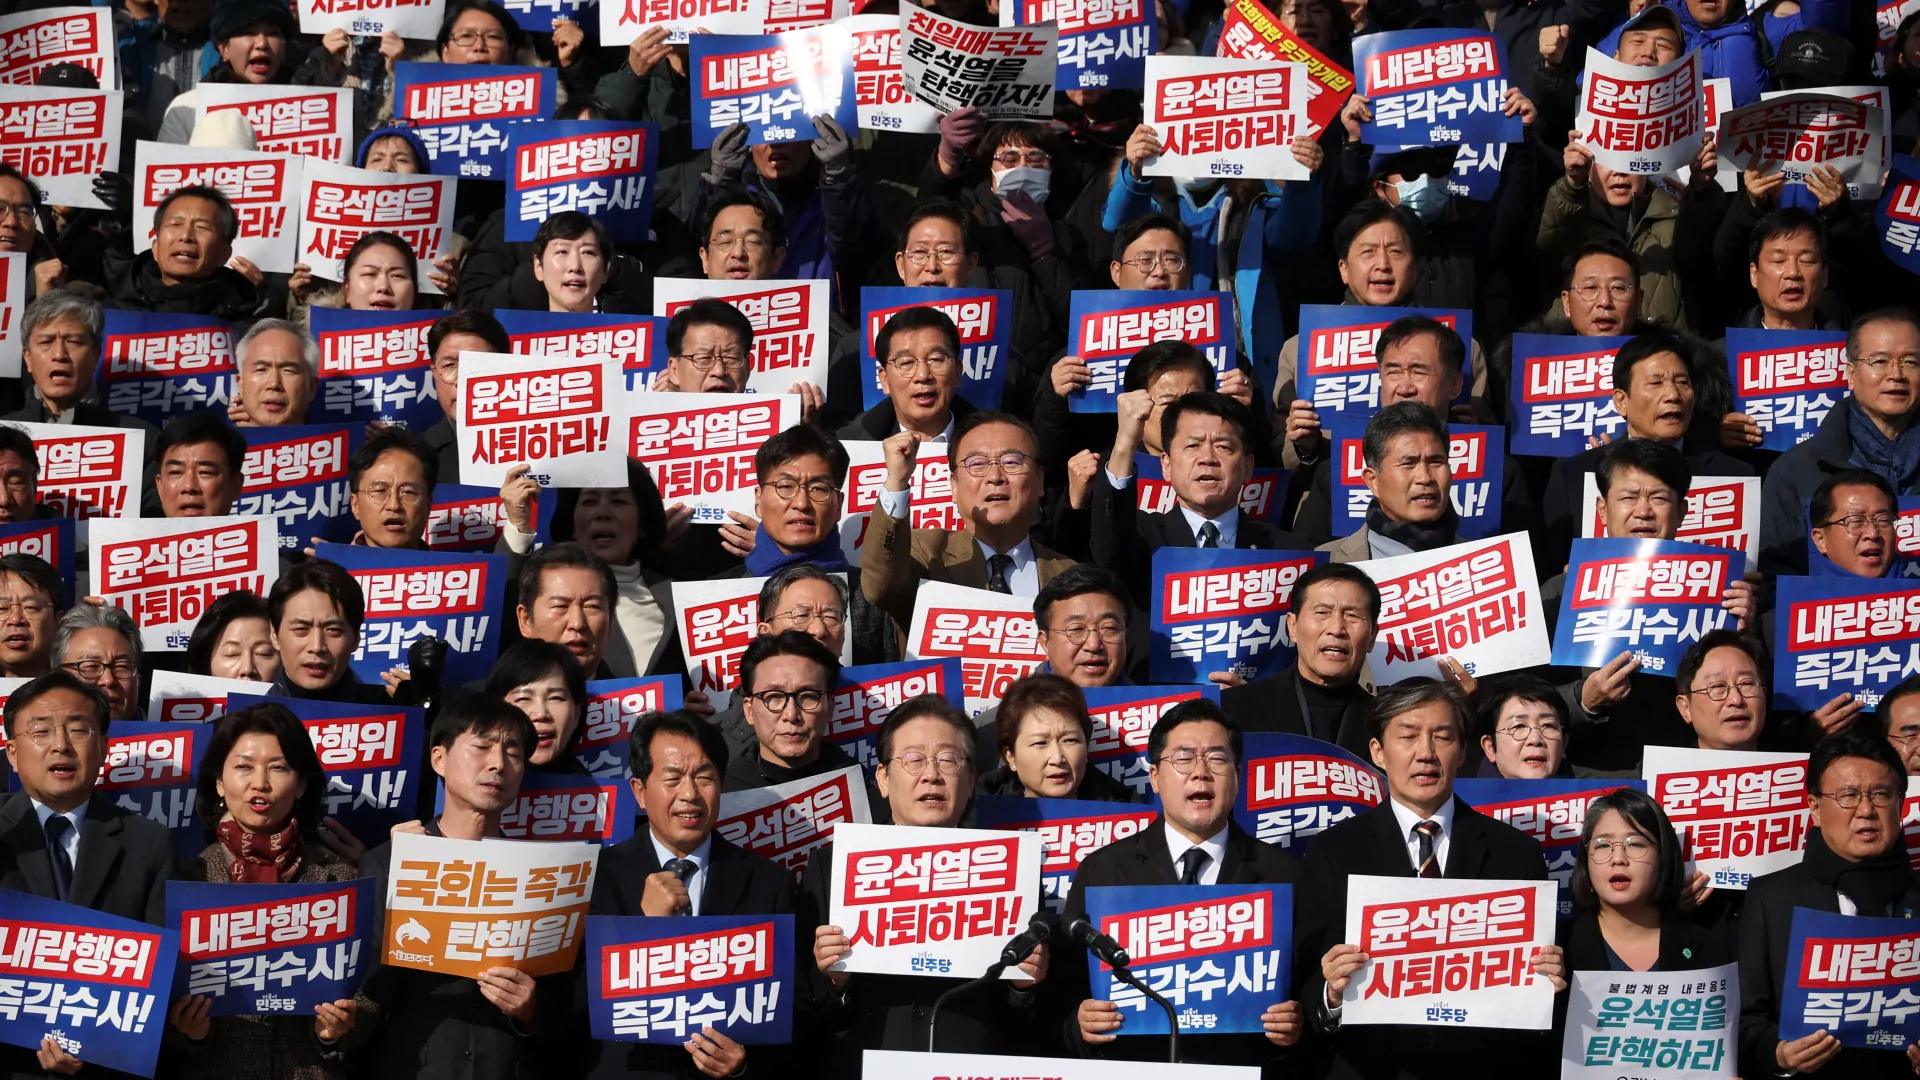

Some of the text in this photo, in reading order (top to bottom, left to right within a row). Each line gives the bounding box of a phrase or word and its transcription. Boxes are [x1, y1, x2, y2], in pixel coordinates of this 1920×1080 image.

[352, 21, 384, 33] 민주당
[906, 11, 1048, 56] 친일매국노
[1057, 26, 1150, 68] 각수사!
[906, 36, 1028, 81] 윤석열을
[1078, 74, 1109, 86] 민주당
[1278, 40, 1353, 90] 우크라개입
[1372, 40, 1495, 89] 내란행위
[409, 77, 534, 120] 내란행위
[919, 68, 1052, 108] 탄핵하자!
[1162, 72, 1284, 116] 윤석열은
[1374, 79, 1507, 128] 즉각수사!
[1593, 66, 1696, 116] 윤석열은
[0, 100, 97, 139] 석열은
[248, 98, 330, 138] 석열은
[763, 128, 796, 141] 민주당
[871, 115, 903, 128] 민주당
[1160, 113, 1297, 158] 사퇴하라!
[1429, 129, 1462, 142] 민주당
[1586, 104, 1699, 153] 사퇴하라!
[1736, 100, 1853, 127] 윤석열은
[1, 143, 107, 178] 퇴하라!
[420, 124, 509, 160] 즉각수
[520, 134, 640, 182] 내란행위
[1733, 131, 1867, 161] 사퇴하라!
[460, 165, 492, 176] 민주당
[1210, 162, 1244, 175] 민주당
[1629, 160, 1663, 172] 민주당
[313, 184, 435, 223] 윤석열은
[519, 176, 646, 223] 즉각수사!
[307, 226, 442, 261] 사퇴라!
[742, 291, 801, 331] 열은
[1085, 302, 1215, 352] 내란행위
[111, 331, 236, 373] 내란행위
[748, 333, 814, 373] 하라!
[1315, 326, 1378, 368] 내란
[109, 374, 238, 414] 즉각수사
[323, 374, 437, 414] 즉각수
[472, 370, 594, 412] 윤석열은
[1531, 349, 1616, 396] 내란
[637, 406, 772, 456] 윤석열은
[1530, 397, 1627, 438] 즉각수
[1744, 393, 1838, 432] 즉각수
[37, 439, 115, 480] 열은
[242, 440, 343, 484] 란행위
[471, 415, 609, 465] 사퇴하라!
[1687, 489, 1735, 529] 열은
[108, 528, 249, 588] 윤석열은
[361, 568, 480, 613] 란행위
[1170, 561, 1308, 616] 내란행위
[1378, 550, 1506, 620] 윤석열은
[1579, 558, 1721, 603] 내란행위
[166, 636, 190, 649] 민주
[691, 600, 758, 648] 윤석
[930, 612, 1042, 654] 윤석열
[1170, 612, 1296, 662] 즉각수
[1385, 591, 1527, 667] 사퇴하라!
[1573, 607, 1728, 648] 즉각수사!
[1795, 643, 1920, 690] 즉각수
[587, 689, 656, 741] 행위
[833, 673, 936, 730] 란행위
[1854, 693, 1884, 707] 민주
[102, 737, 185, 784] 행위
[312, 720, 396, 765] 행위
[326, 770, 407, 814] 수사!
[1255, 758, 1382, 804] 내란행위
[1663, 766, 1805, 815] 윤석열은
[500, 792, 609, 837] 란행위
[1042, 818, 1149, 870] 란행위
[396, 859, 592, 908] 국회는 즉각
[854, 845, 1009, 899] 윤석열은
[1715, 871, 1752, 887] 민주당
[189, 895, 350, 953] 내란행위
[445, 912, 580, 961] 탄핵을!
[850, 896, 1024, 949] 사퇴하라!
[1108, 898, 1265, 964] 내란행위
[1369, 894, 1526, 951] 윤석열은
[0, 926, 151, 982] 내란행위
[189, 938, 361, 998] 즉각수사!
[389, 949, 434, 967] 사회민주당
[610, 930, 767, 991] 내란행위
[911, 957, 953, 973] 민주당
[1364, 946, 1543, 1001] 사퇴하라!
[1808, 938, 1920, 983] 내란행
[1109, 950, 1280, 1011] 즉각수사!
[1608, 983, 1669, 996] 불법계엄
[0, 979, 156, 1034] 즉각수사!
[256, 997, 297, 1012] 민주당
[612, 981, 781, 1039] 즉각수사!
[1177, 1013, 1218, 1029] 민주당
[1426, 1007, 1468, 1023] 민주당
[1596, 994, 1726, 1031] 윤석열을
[1804, 988, 1920, 1030] 즉각수
[1584, 1035, 1726, 1071] 탄핵하라
[1866, 1033, 1907, 1047] 민주당
